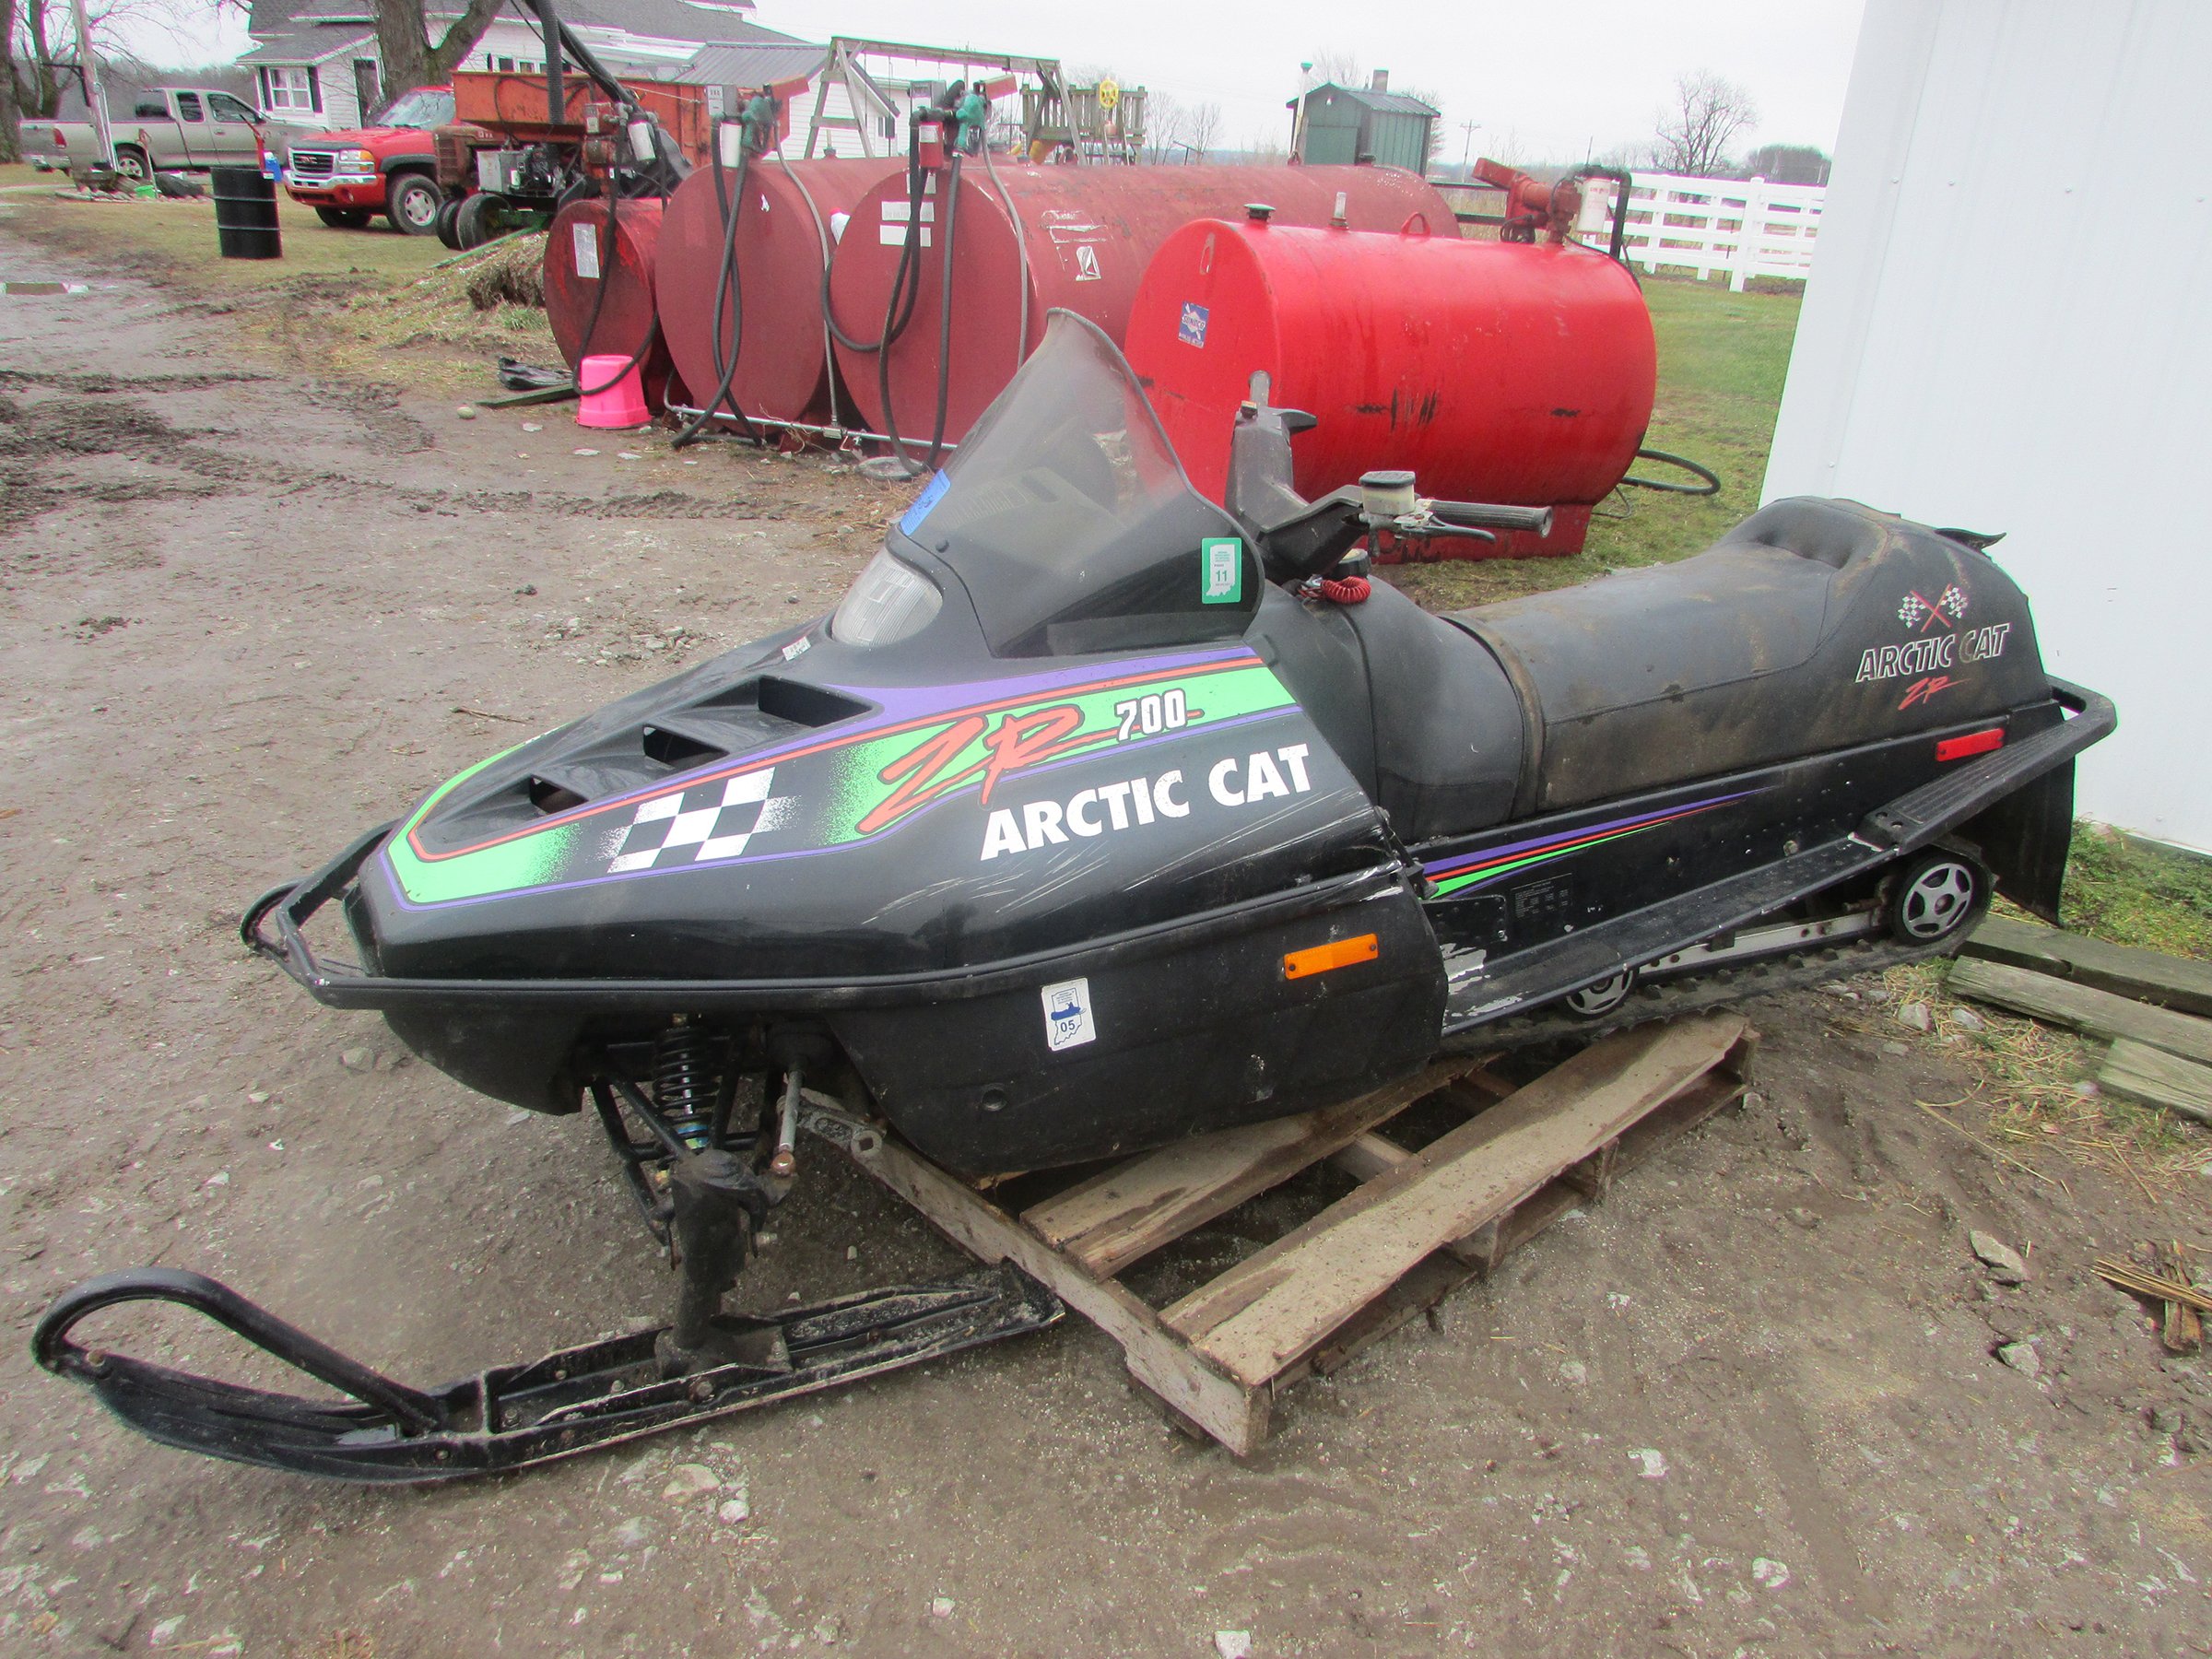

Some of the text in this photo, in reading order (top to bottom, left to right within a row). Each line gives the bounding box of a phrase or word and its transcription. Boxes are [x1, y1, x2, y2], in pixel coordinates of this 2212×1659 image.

[1182, 315, 1206, 330] SUNOCO
[1216, 570, 1228, 582] 11
[1854, 622, 2011, 683] ARCTIC CAT
[1897, 676, 1967, 711] ZR
[857, 688, 1186, 833] ZR 700
[980, 743, 1311, 861] ARCTIC CAT
[1060, 1019, 1075, 1031] 05
